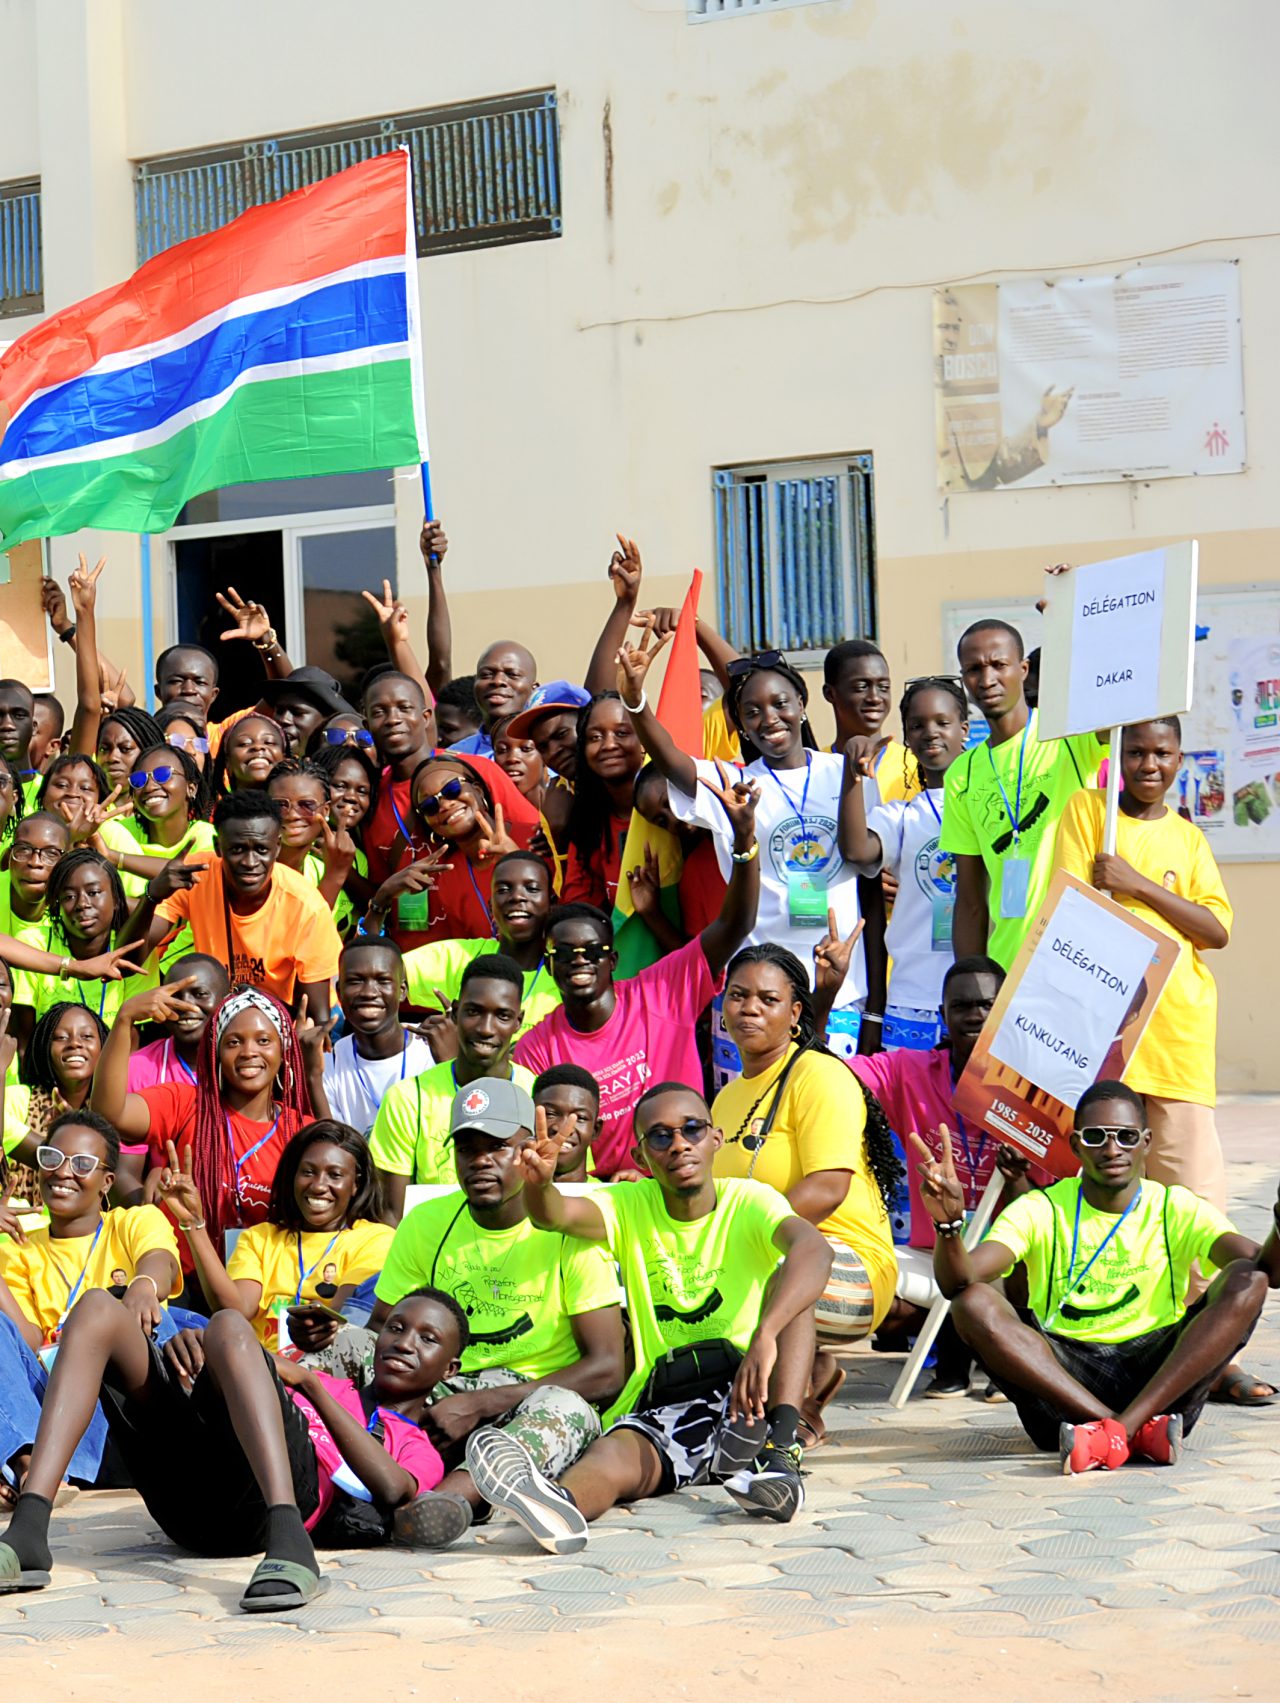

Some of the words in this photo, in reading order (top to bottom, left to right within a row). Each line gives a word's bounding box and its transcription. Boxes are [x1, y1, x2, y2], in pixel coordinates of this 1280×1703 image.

[1082, 589, 1155, 617] DÉLÉGATION
[1096, 668, 1133, 688] DAKAR
[1052, 938, 1128, 996] DÉLÉGATION
[1015, 1014, 1089, 1069] KUNKUJANG
[991, 1098, 1019, 1121] 1985
[1025, 1121, 1054, 1145] 2025
